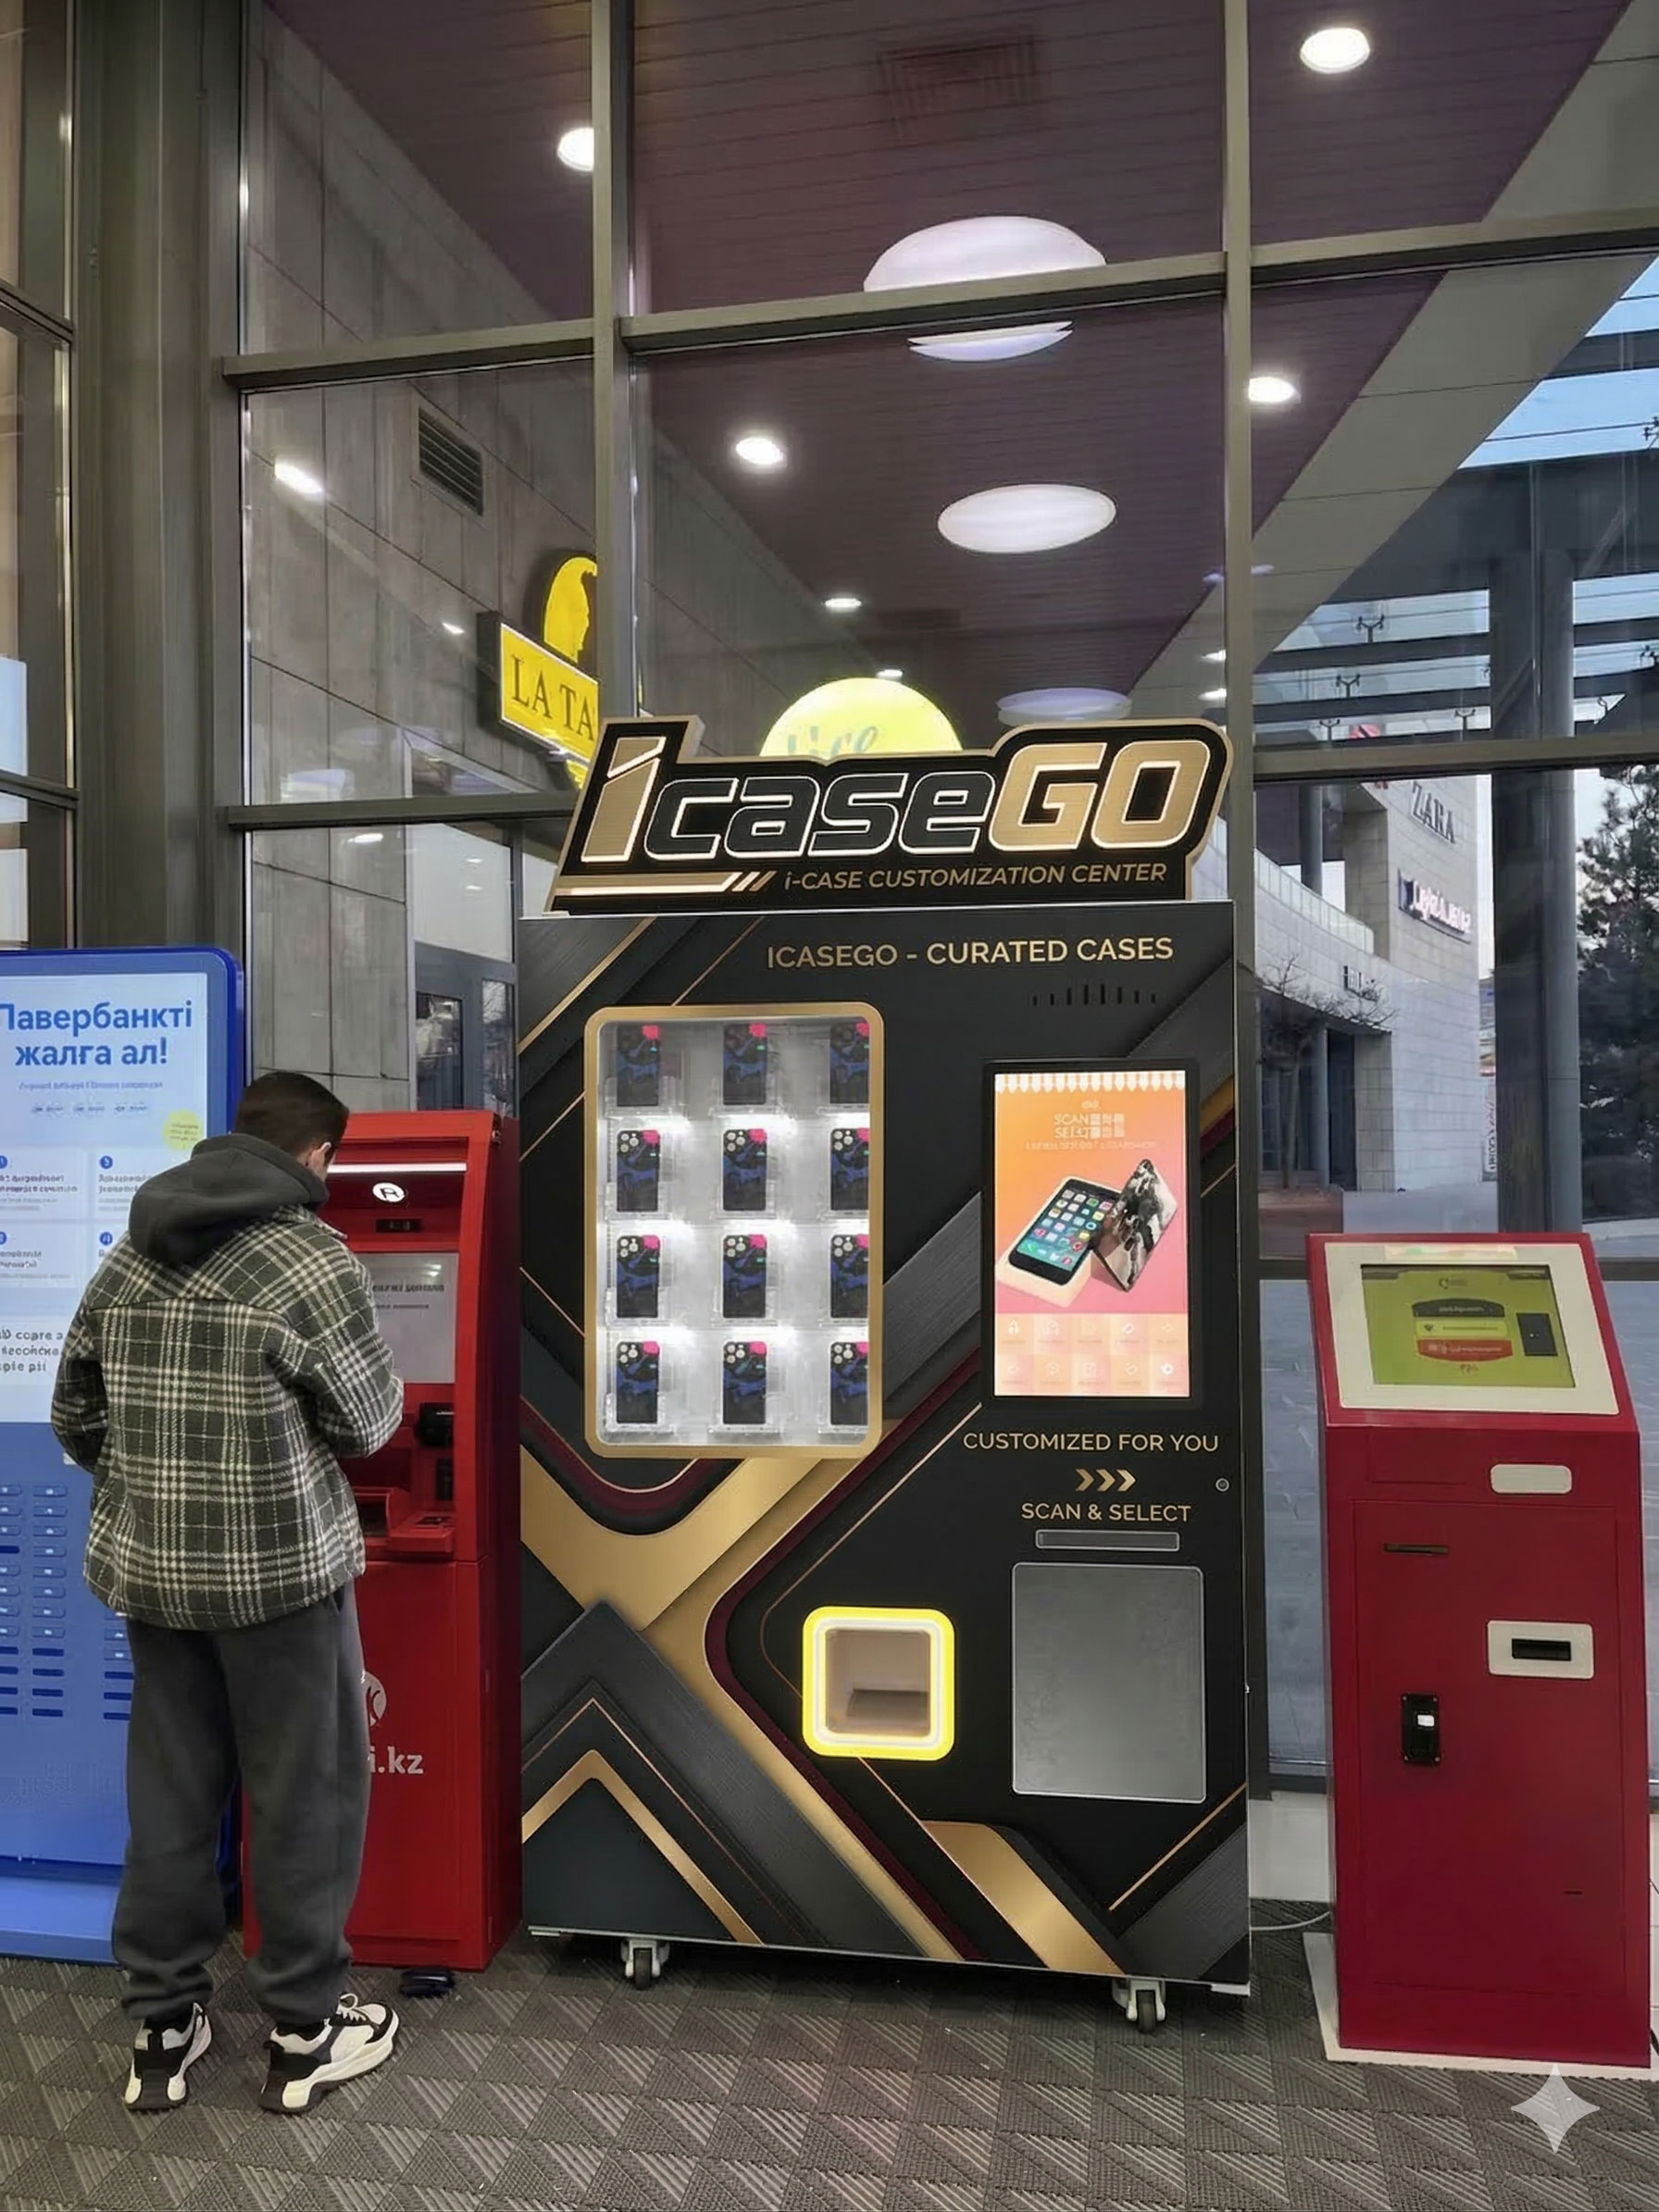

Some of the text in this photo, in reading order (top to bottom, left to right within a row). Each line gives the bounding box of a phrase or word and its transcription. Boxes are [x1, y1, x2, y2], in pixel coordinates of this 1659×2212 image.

[511, 653, 595, 742] LA TA
[1412, 780, 1455, 844] ZARA
[868, 865, 1066, 889] CUSTOMIZATION
[1072, 863, 1166, 884] CENTER
[767, 944, 898, 969] ICASEGO
[926, 939, 1068, 965] CURATED
[1076, 937, 1174, 963] CASES
[121, 1037, 168, 1065] ал!
[1054, 1113, 1089, 1125] SCAN
[963, 1433, 1219, 1452] CUSTOMIZED FOR YOU
[1021, 1502, 1191, 1522] SCAN & SELECT
[368, 1746, 424, 1774] i.kz
